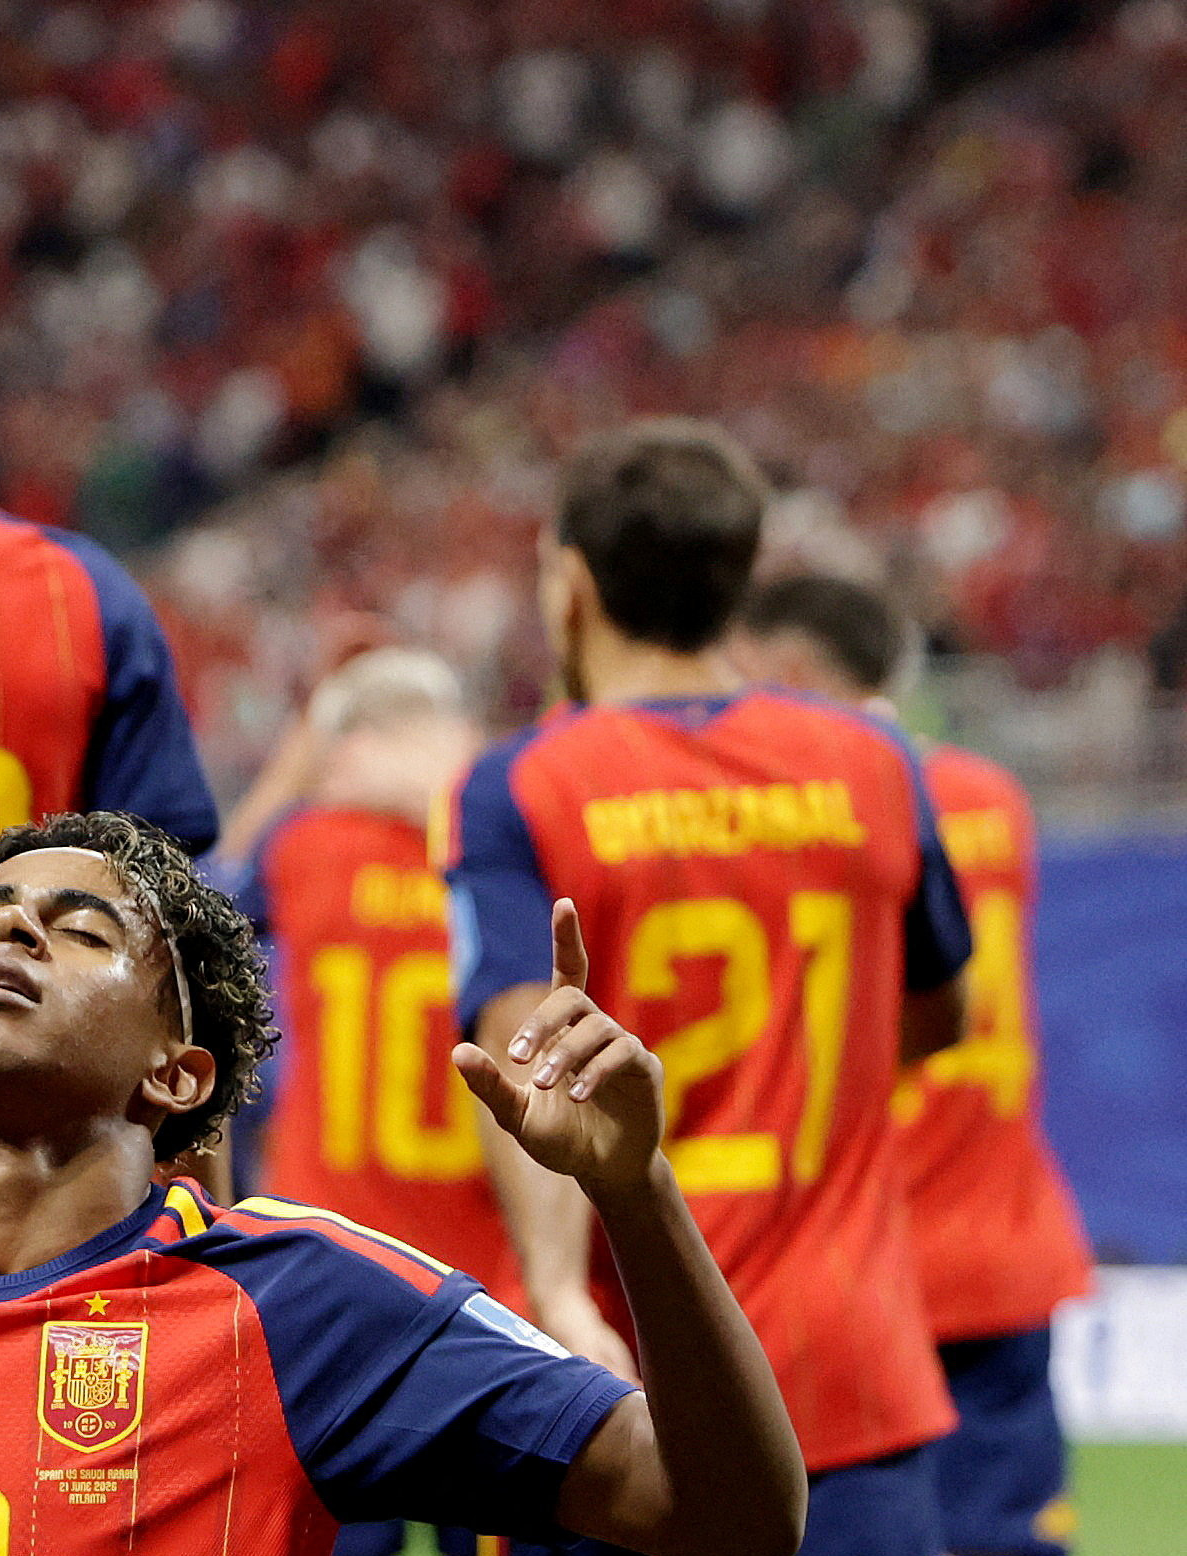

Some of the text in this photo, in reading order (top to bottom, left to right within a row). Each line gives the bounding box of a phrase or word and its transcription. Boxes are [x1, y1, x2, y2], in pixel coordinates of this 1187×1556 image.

[627, 890, 852, 1195] 21
[314, 943, 483, 1179] 10
[79, 1468, 105, 1480] SAUDI
[59, 1481, 69, 1492] 21
[68, 1493, 107, 1504] ATLANTA
